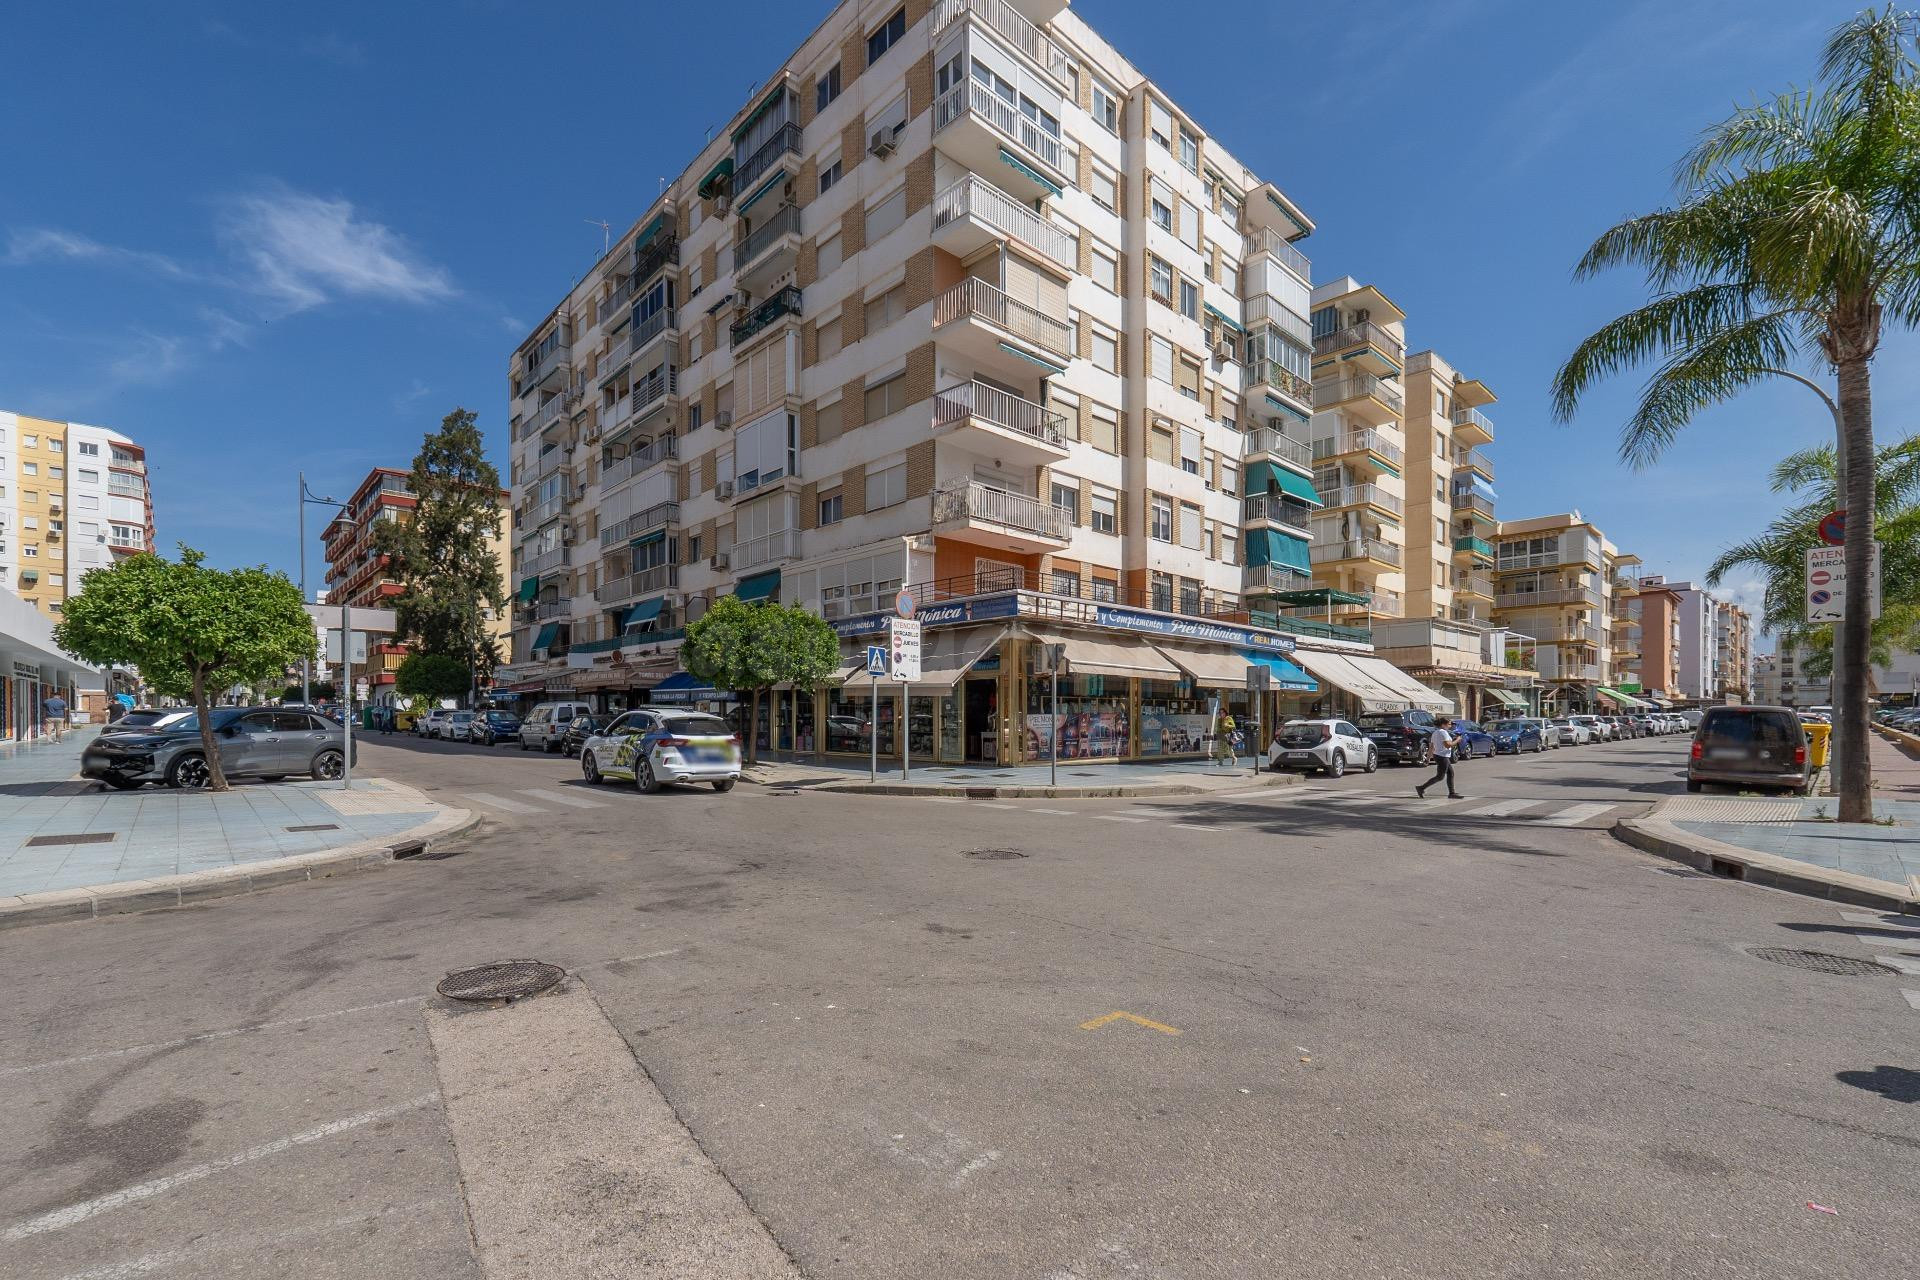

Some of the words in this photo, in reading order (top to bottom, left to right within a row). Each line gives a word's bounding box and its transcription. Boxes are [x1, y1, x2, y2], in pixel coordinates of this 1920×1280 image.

[1109, 609, 1164, 630] Complementos
[1171, 619, 1197, 634] Piel
[1199, 623, 1243, 641] Mónica
